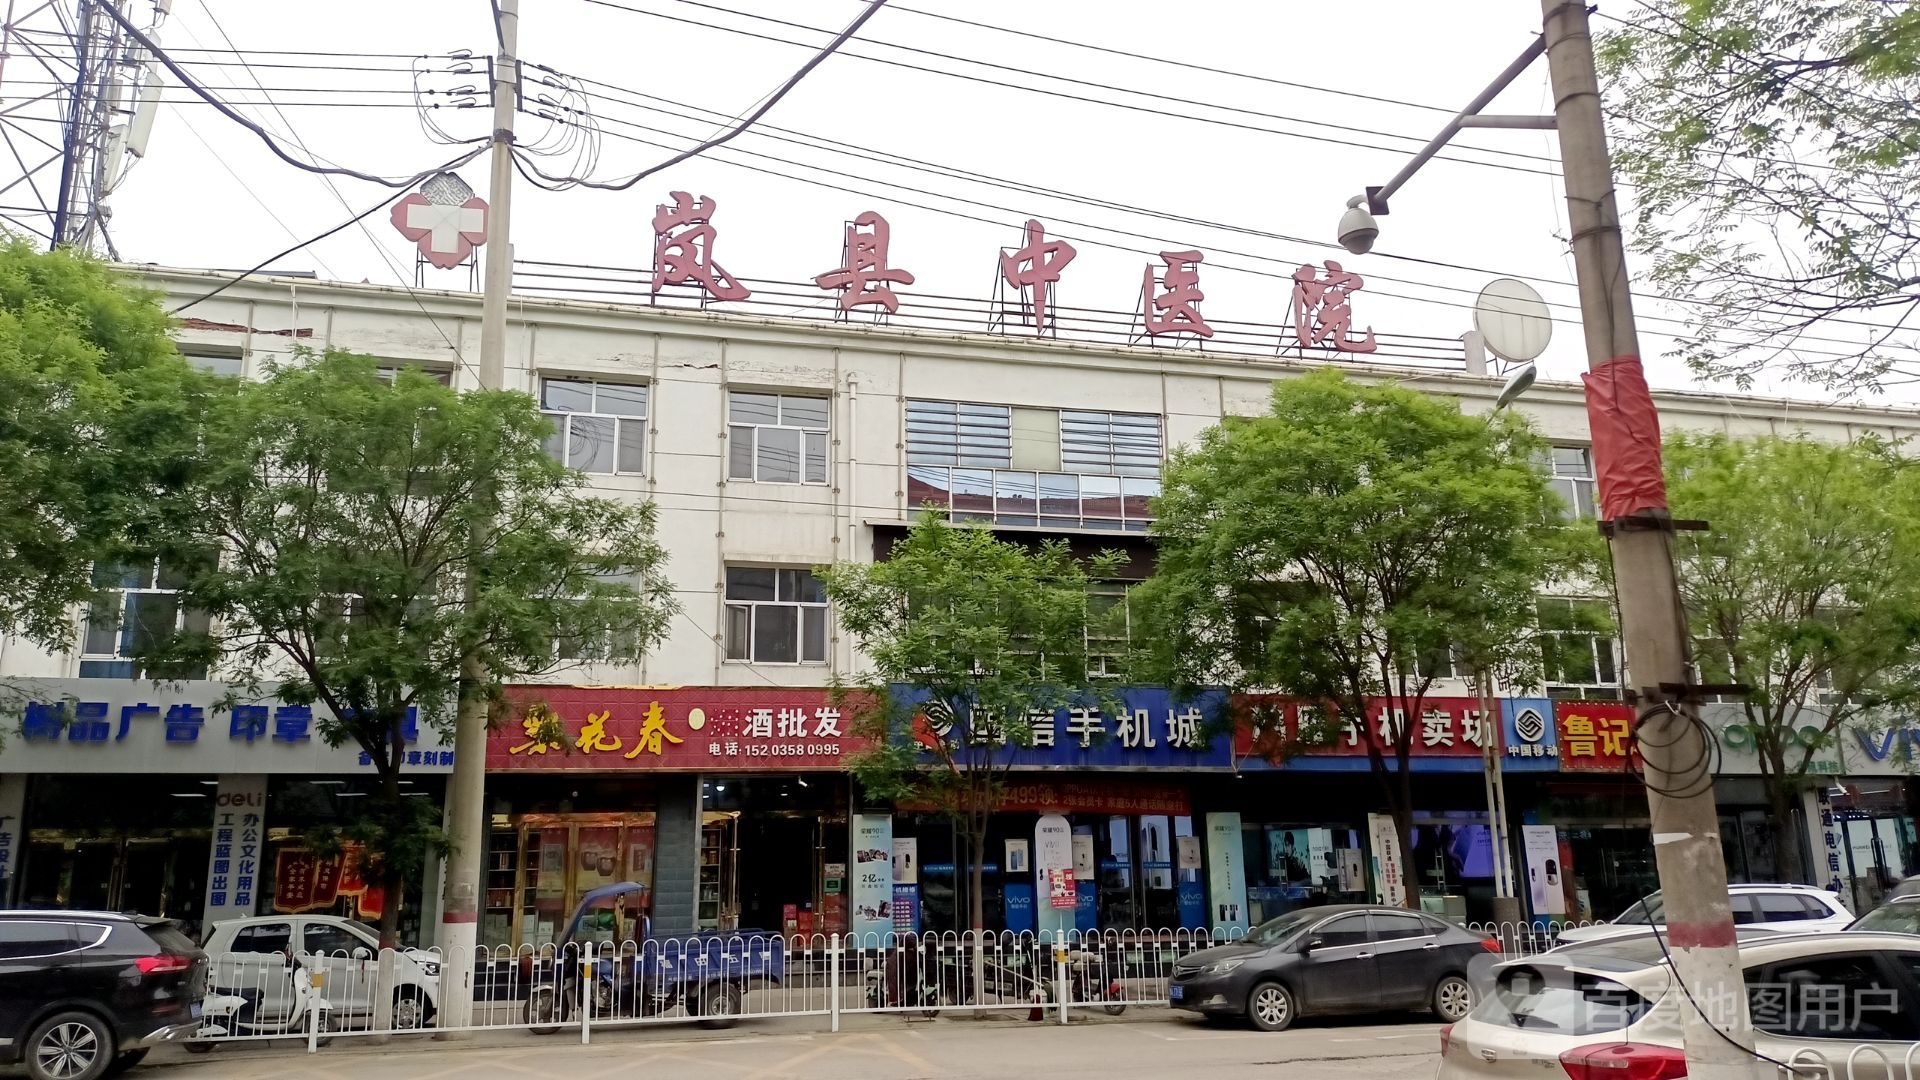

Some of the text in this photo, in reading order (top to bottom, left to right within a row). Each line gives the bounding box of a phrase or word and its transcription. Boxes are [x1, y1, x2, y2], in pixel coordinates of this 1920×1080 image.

[652, 192, 1377, 354] 岚县中医院
[230, 705, 312, 744] 印章
[742, 707, 842, 738] 酒批发
[708, 741, 741, 757] 电话:
[1508, 744, 1558, 757] 中国移动
[217, 793, 262, 807] deli
[211, 813, 235, 906] 工程蓝图出图
[235, 813, 259, 906] 办公文化用品
[1007, 895, 1030, 904] vivo
